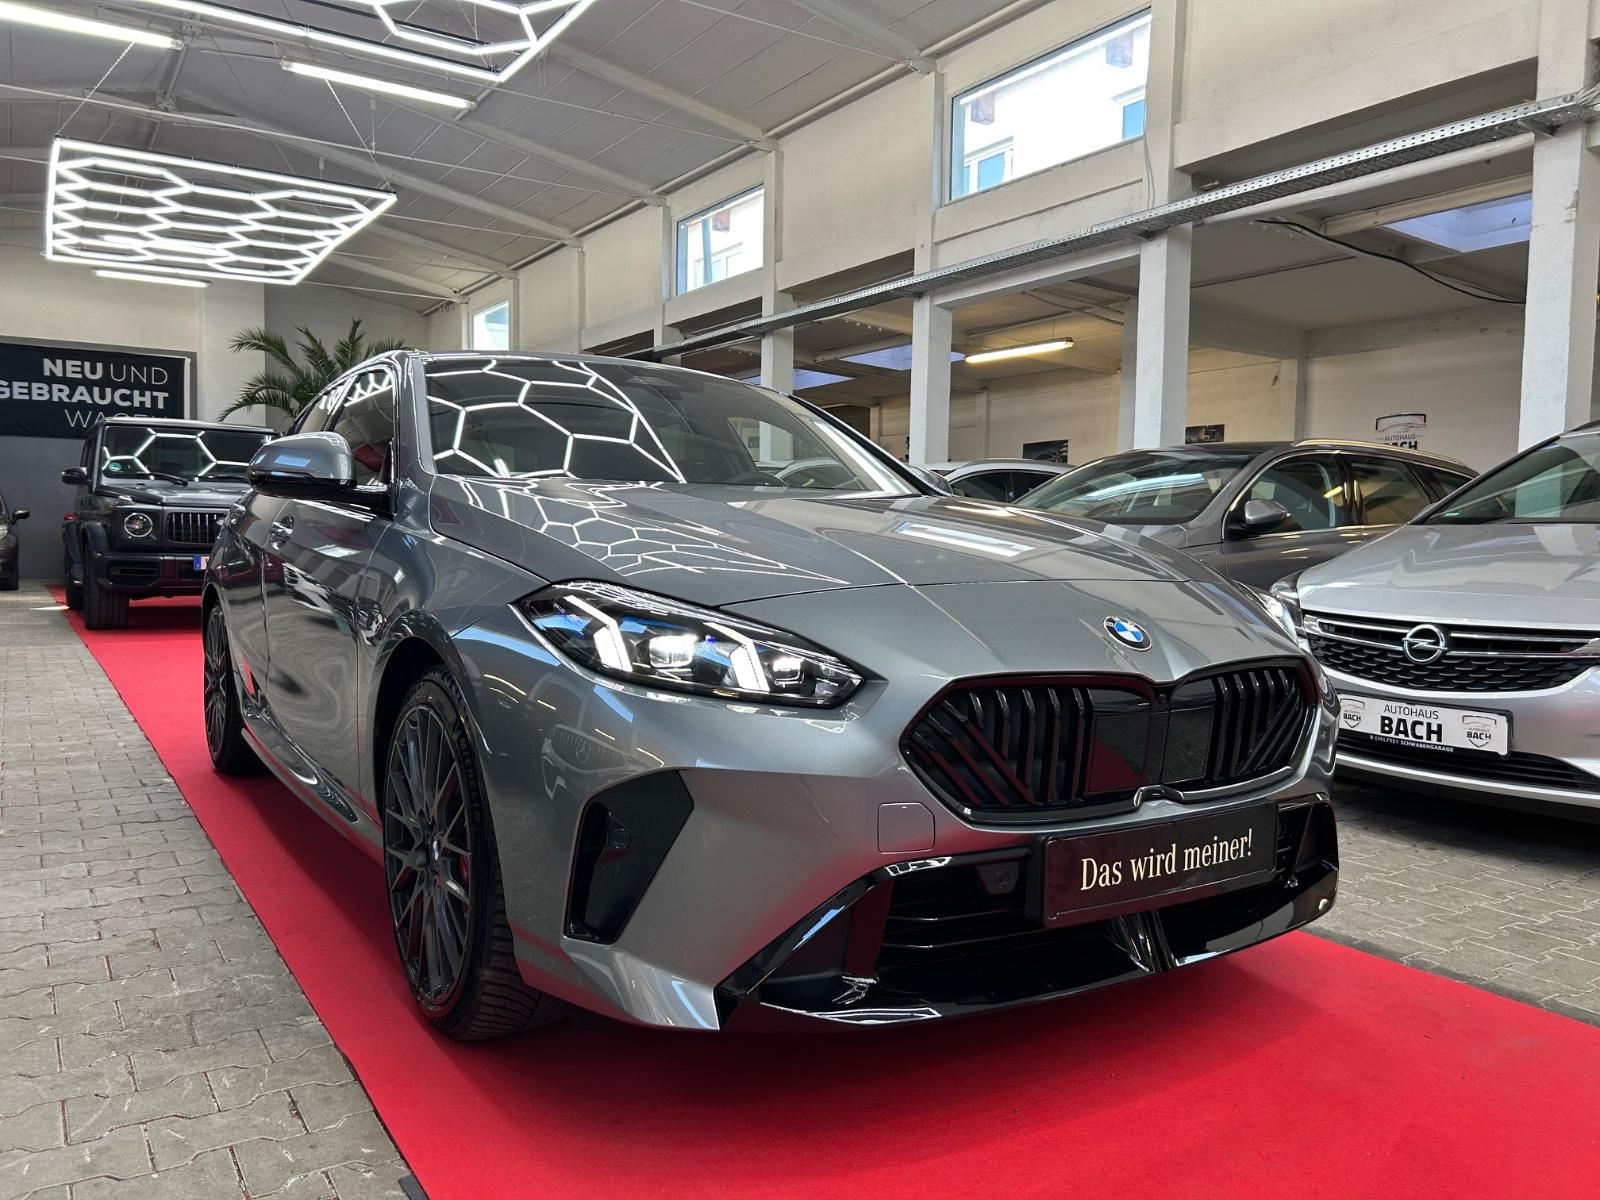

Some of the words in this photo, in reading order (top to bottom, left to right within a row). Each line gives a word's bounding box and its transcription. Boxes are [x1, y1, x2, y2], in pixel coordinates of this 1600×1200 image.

[43, 357, 103, 380] NEU
[110, 363, 168, 386] UND
[0, 379, 169, 410] GEBRAUCHT
[1383, 704, 1439, 720] AUTOHAUS
[1380, 715, 1443, 743] BACH
[1466, 731, 1492, 740] BACH
[1080, 858, 1122, 891] Das
[1130, 843, 1177, 882] wird
[1183, 828, 1253, 871] meiner!
